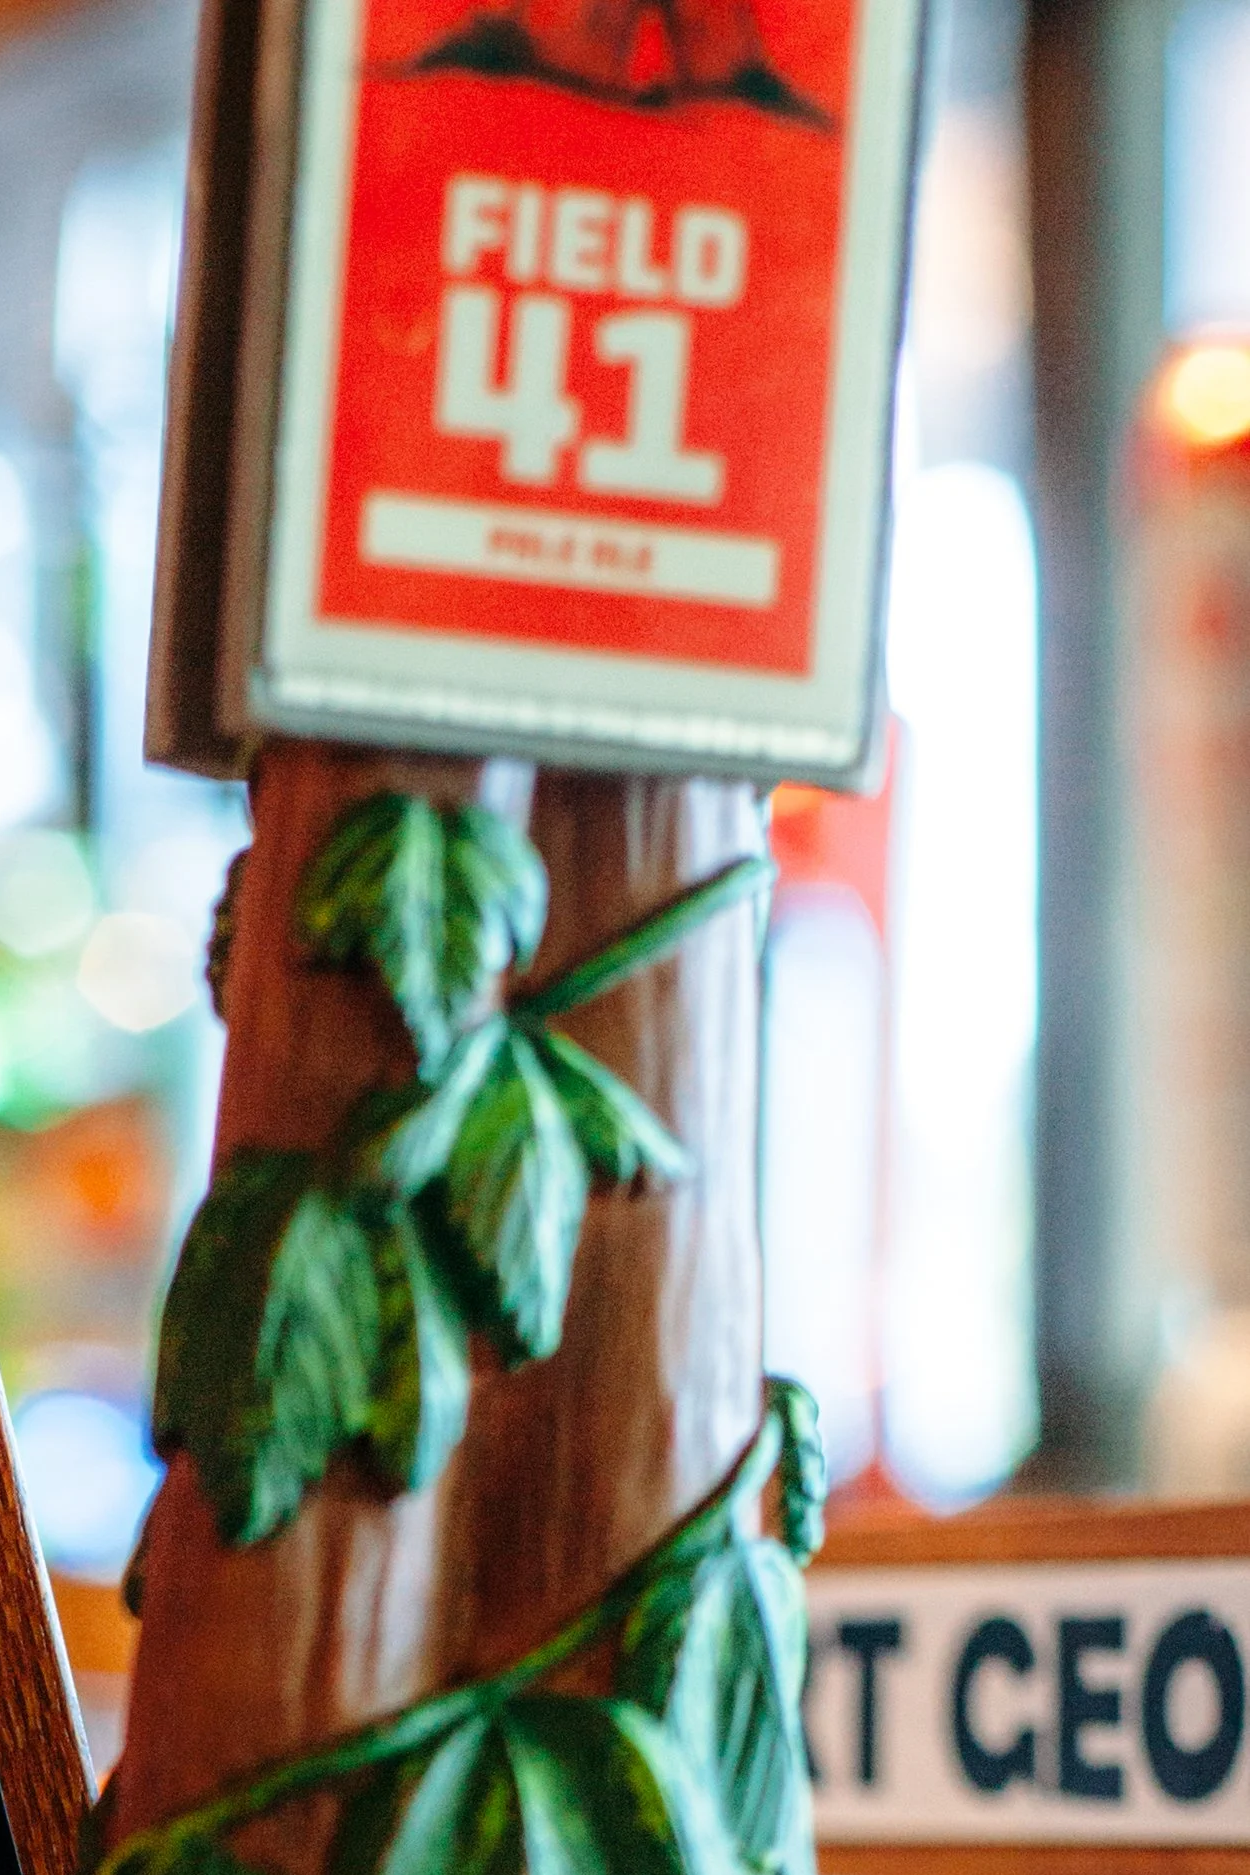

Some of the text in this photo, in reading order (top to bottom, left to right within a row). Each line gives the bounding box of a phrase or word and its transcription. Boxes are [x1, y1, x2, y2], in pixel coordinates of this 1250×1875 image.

[442, 174, 748, 308] FIELD
[434, 284, 726, 505] 41
[800, 1616, 904, 1788] T
